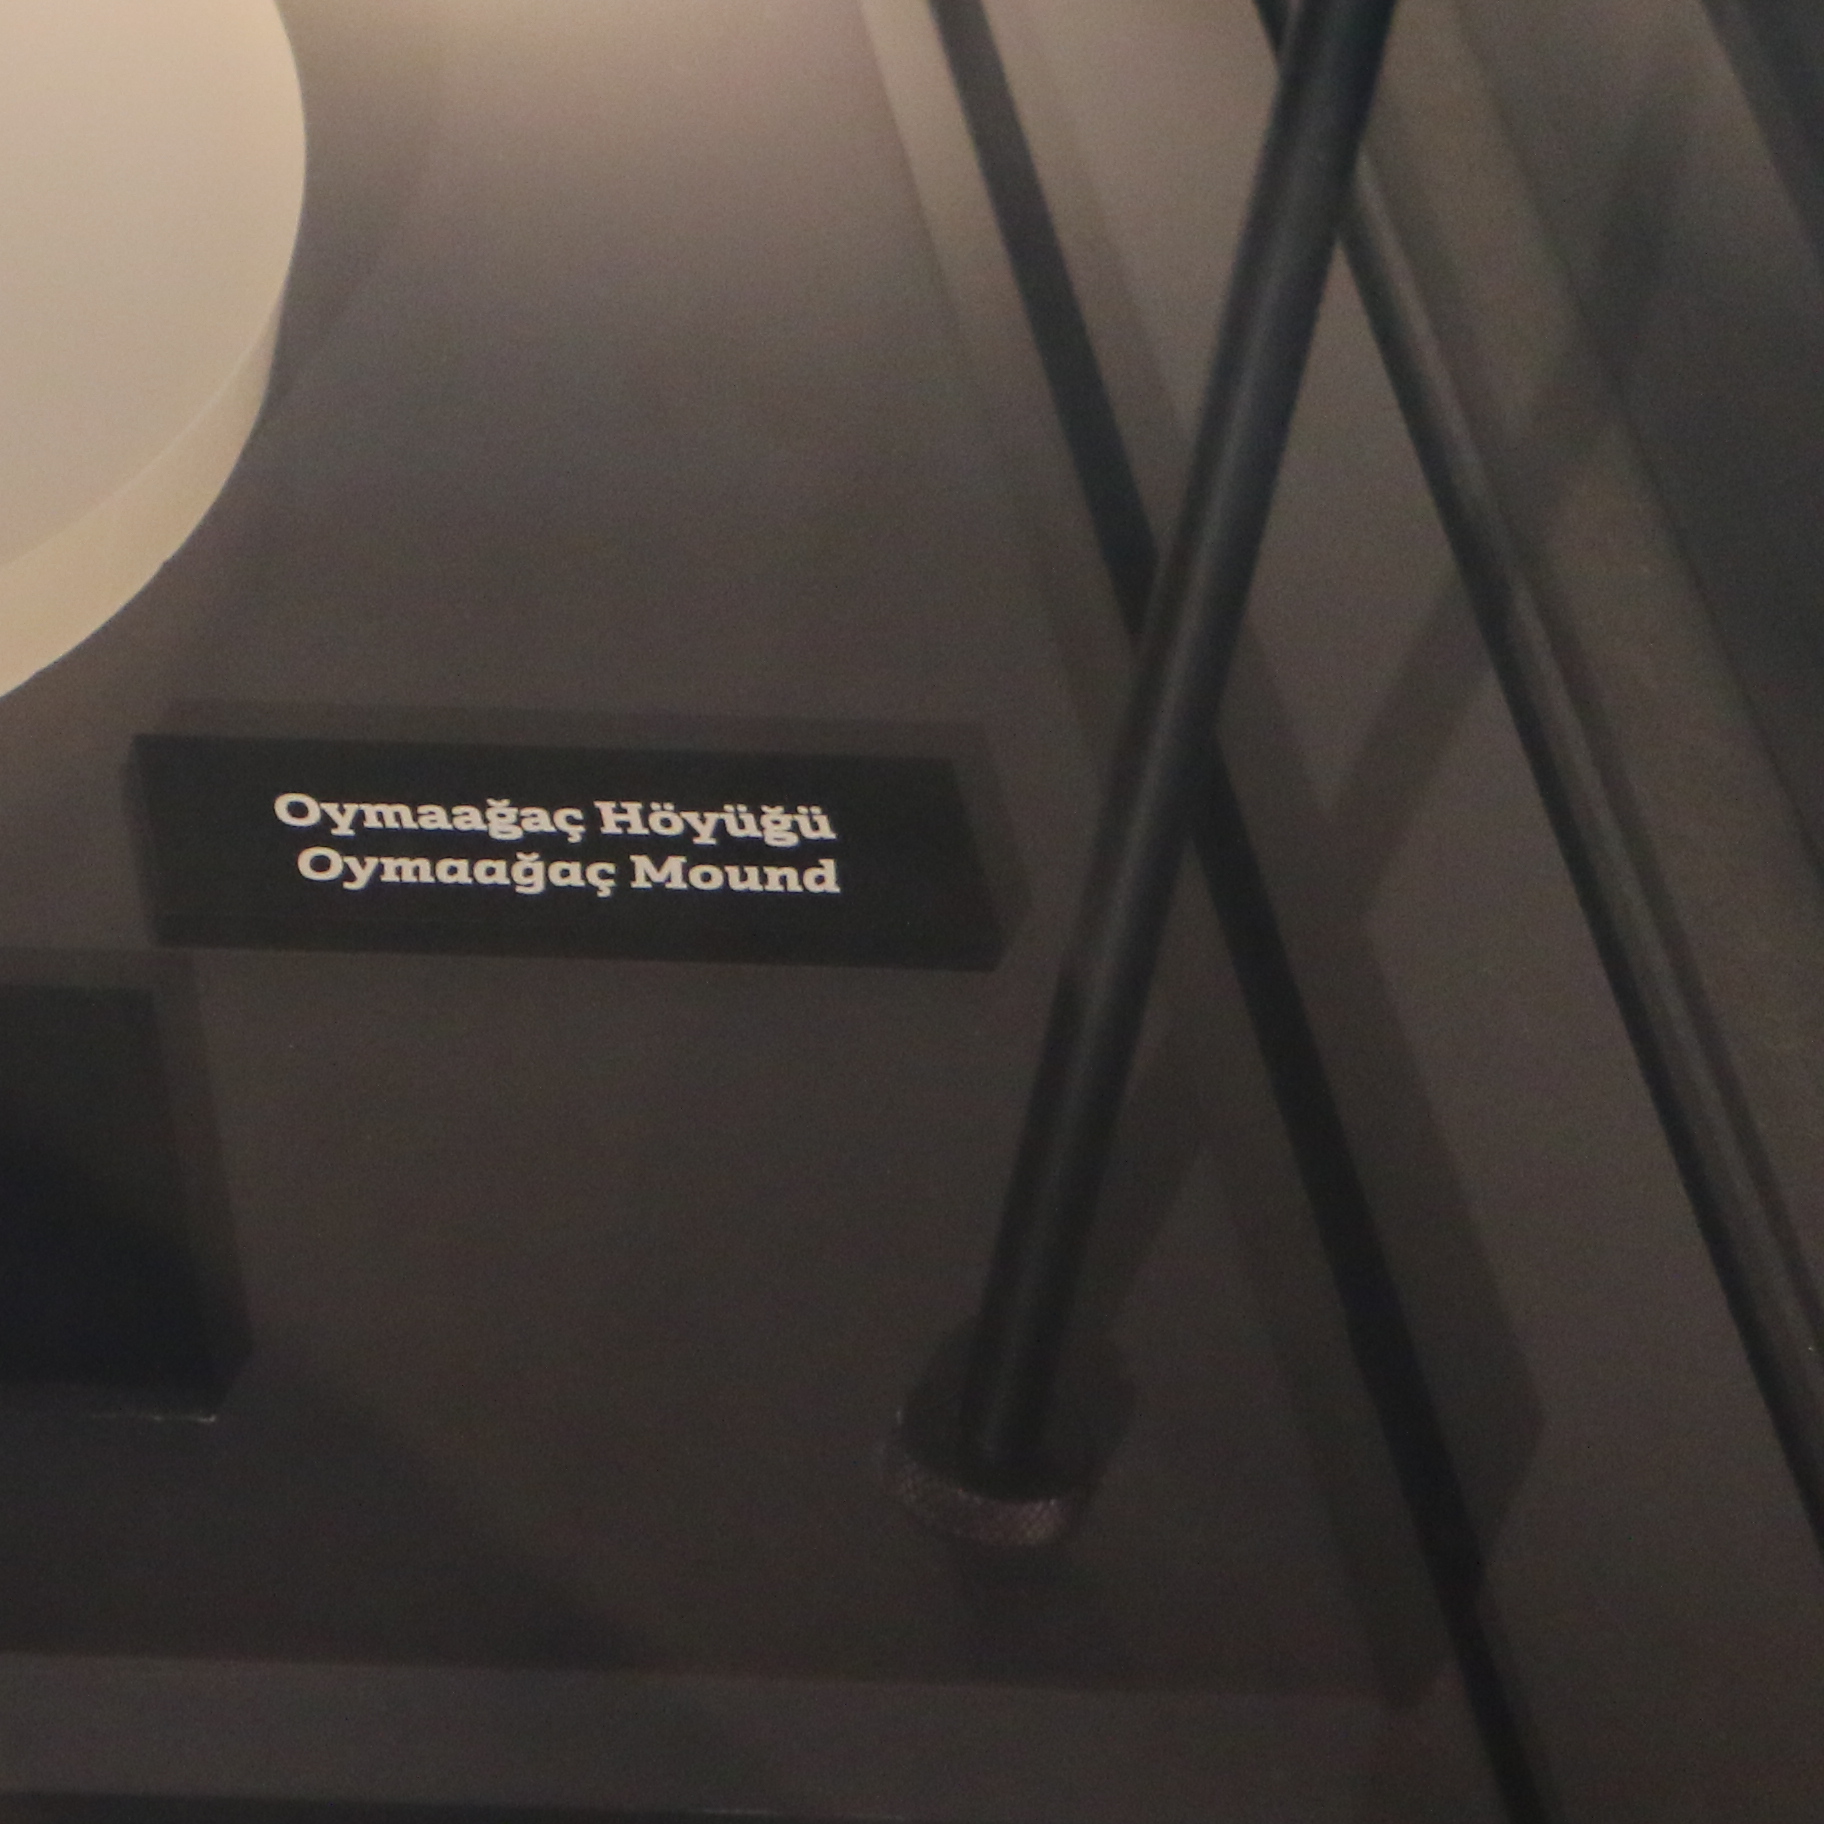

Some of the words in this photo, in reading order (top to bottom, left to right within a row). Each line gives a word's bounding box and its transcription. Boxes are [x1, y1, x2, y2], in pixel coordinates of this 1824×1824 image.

[274, 793, 586, 843] Oymaağaç
[594, 801, 836, 847] Höyüğü
[297, 846, 616, 897] Oymaağaç
[629, 855, 841, 893] Mound
